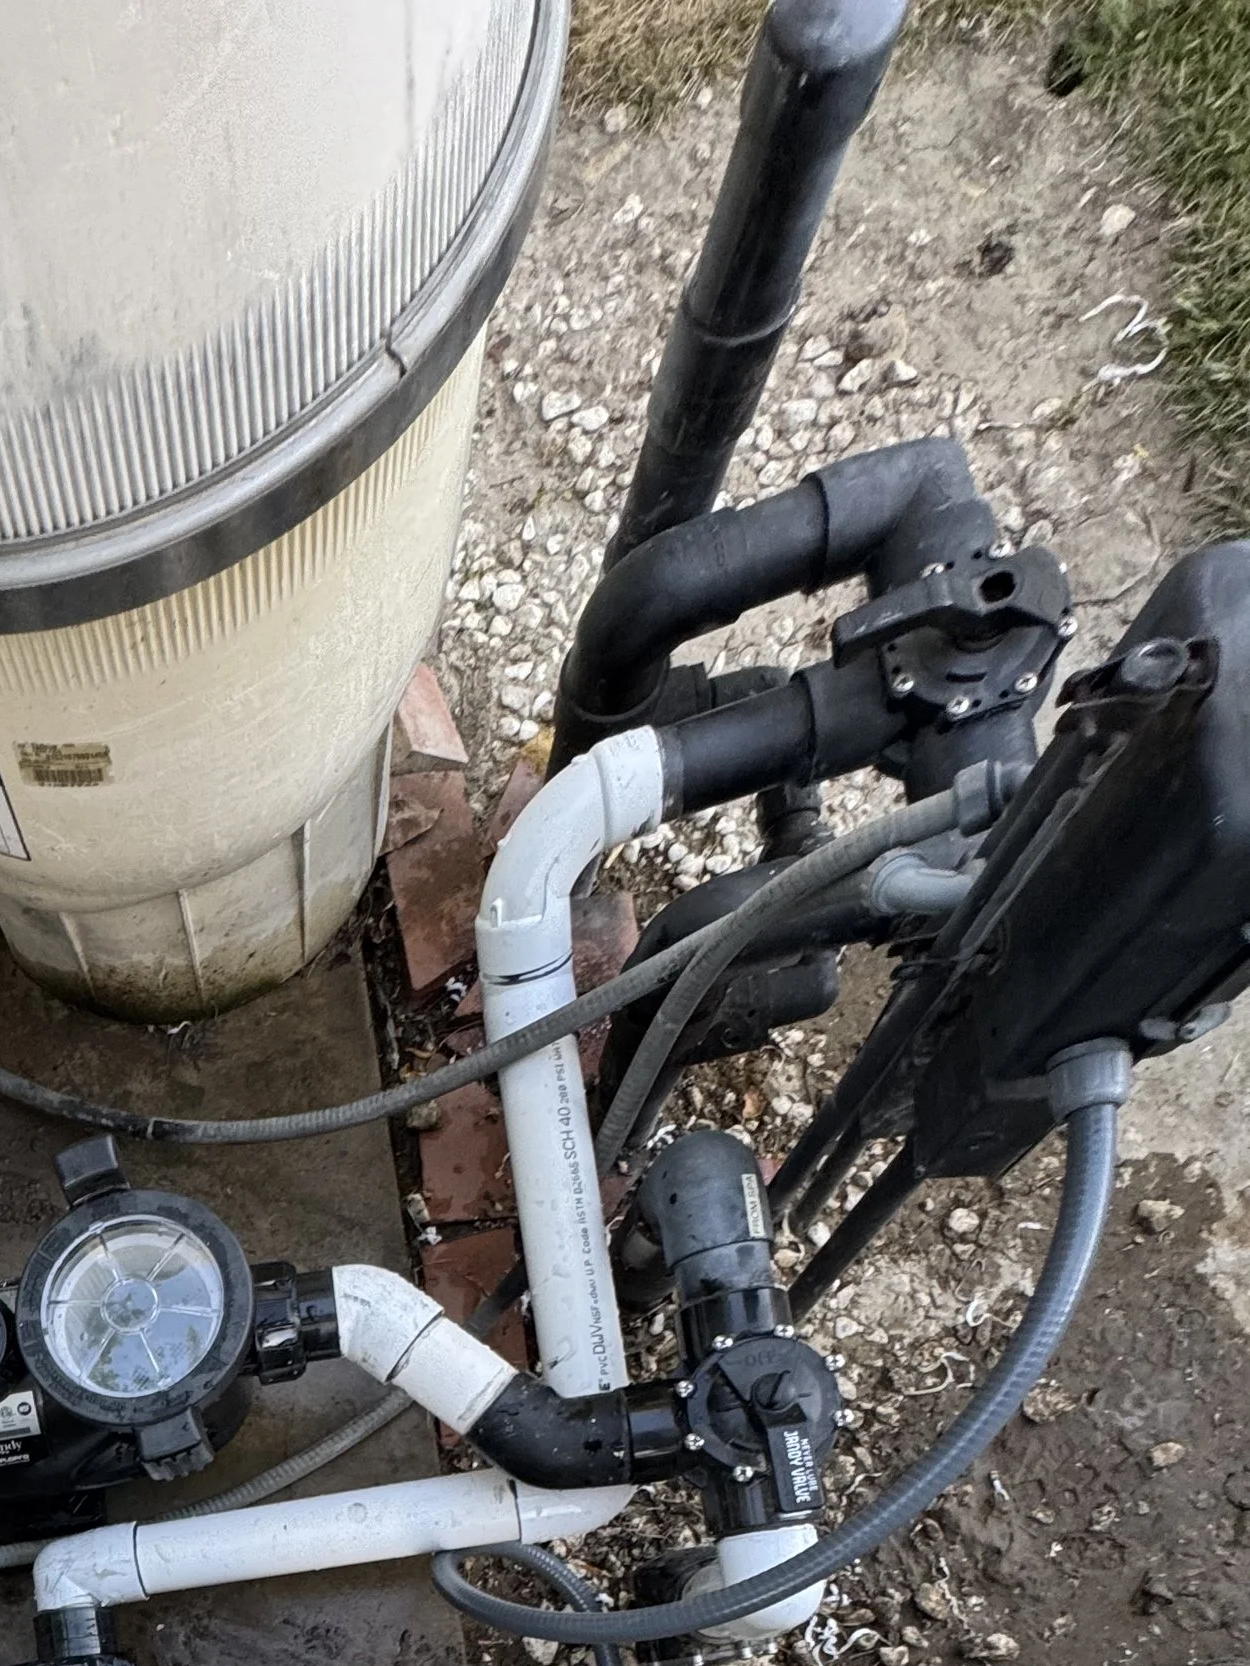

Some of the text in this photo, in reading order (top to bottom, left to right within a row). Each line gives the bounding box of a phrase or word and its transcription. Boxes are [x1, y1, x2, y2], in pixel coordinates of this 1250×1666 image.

[554, 1063, 566, 1082] PSI
[557, 1106, 571, 1127] 40
[559, 1130, 577, 1160] SCH
[575, 1197, 586, 1224] ASTM
[745, 1175, 760, 1234] FROM SPA
[581, 1227, 591, 1254] Code
[588, 1324, 606, 1355] DWV
[598, 1355, 609, 1376] PVC
[783, 1430, 812, 1504] JANDY VALVE
